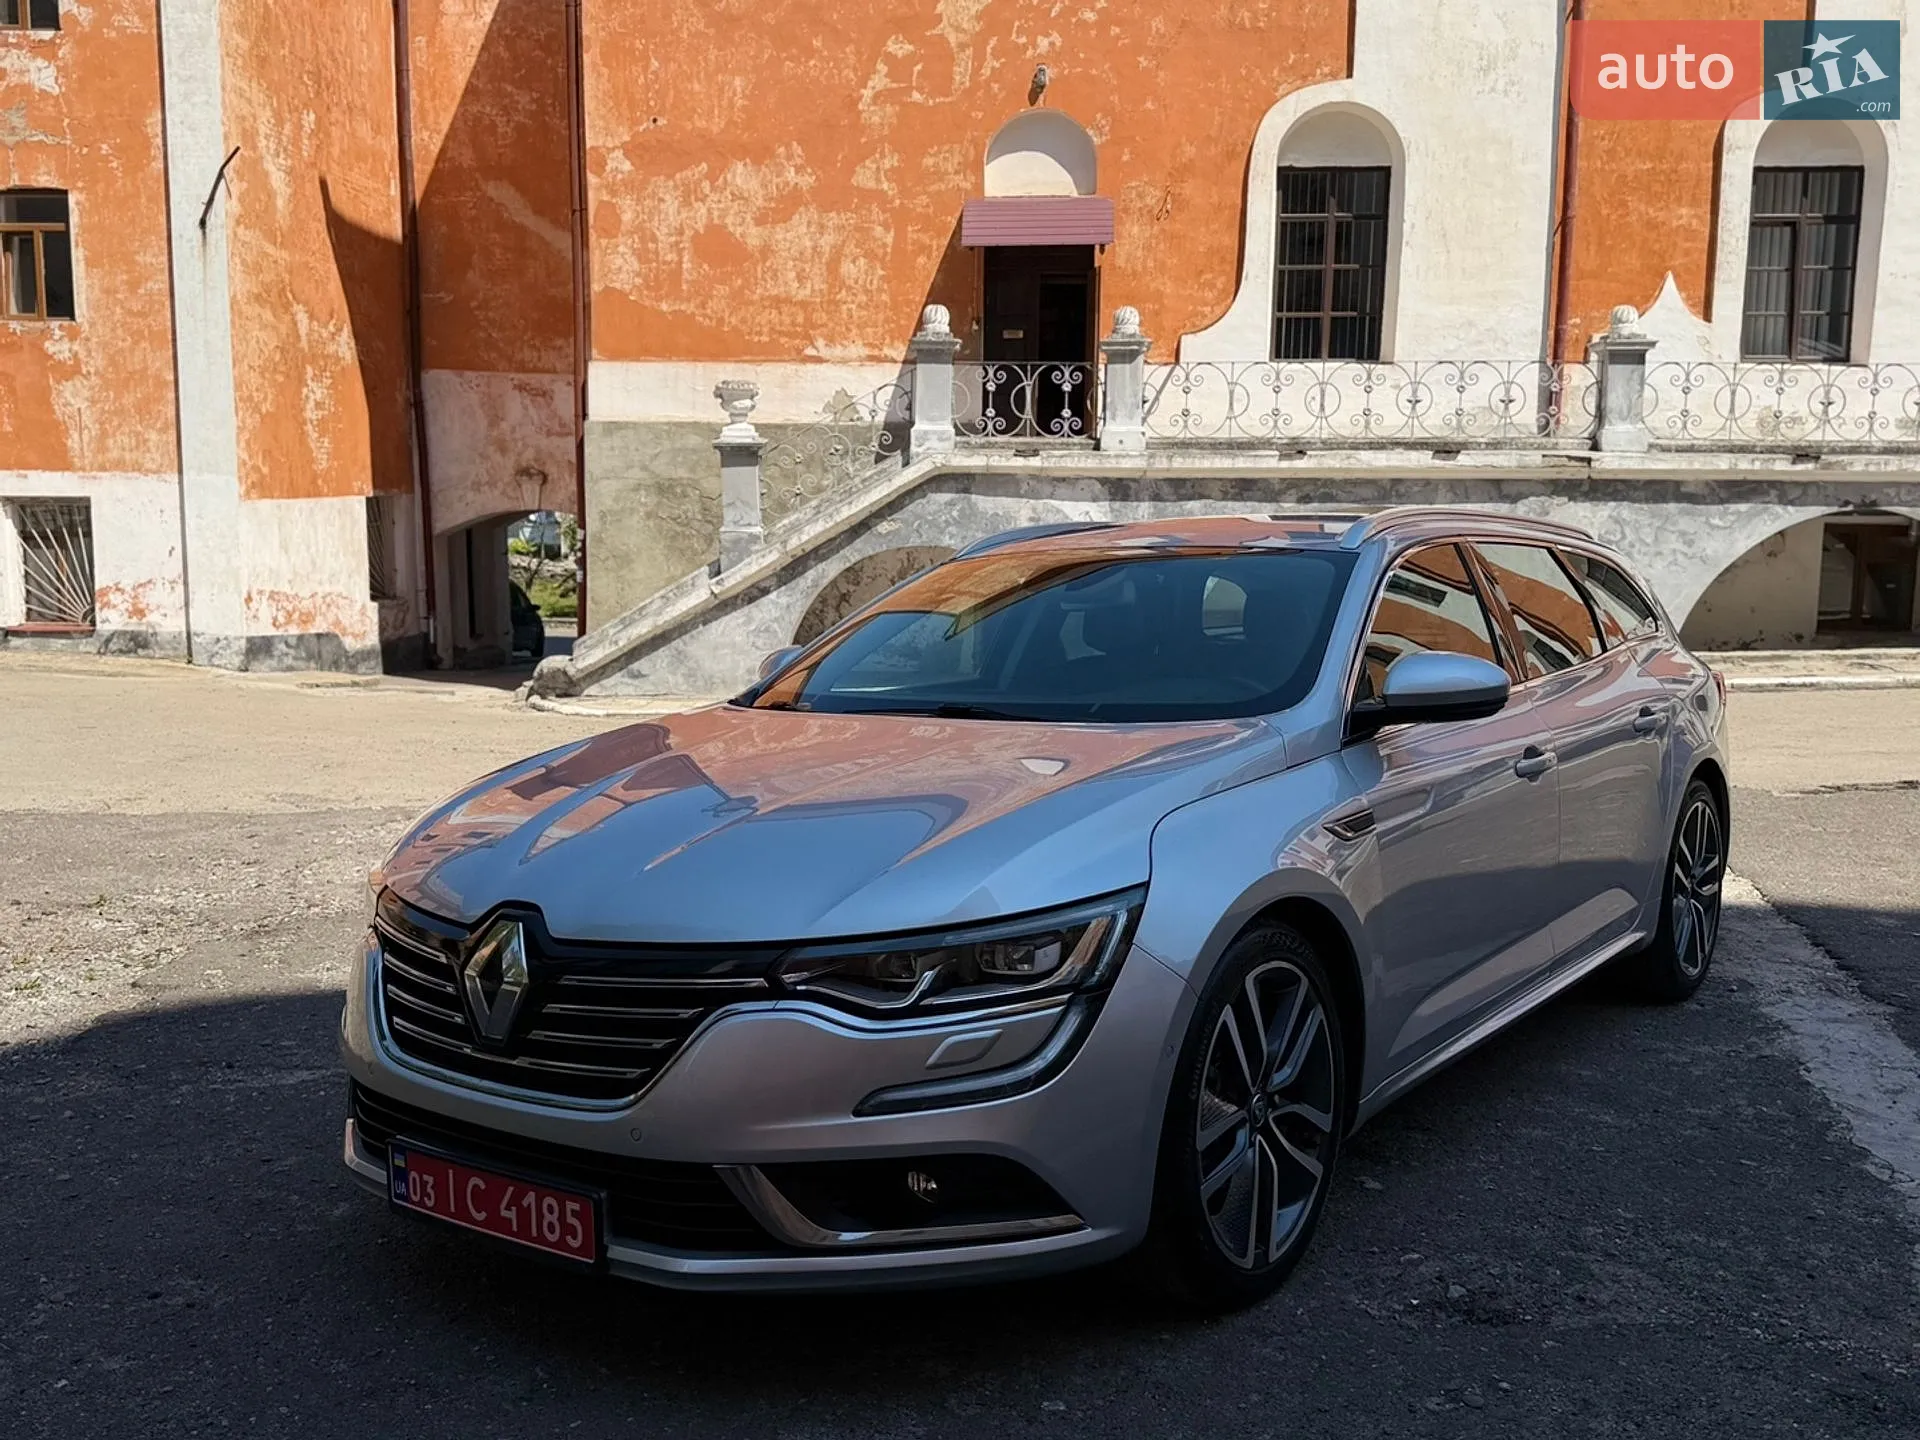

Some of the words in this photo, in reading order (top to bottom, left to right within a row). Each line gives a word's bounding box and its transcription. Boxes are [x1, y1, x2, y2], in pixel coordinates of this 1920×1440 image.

[395, 1180, 407, 1196] UA
[408, 1171, 435, 1208] 03
[448, 1169, 487, 1221] IC
[500, 1186, 583, 1248] 4185
